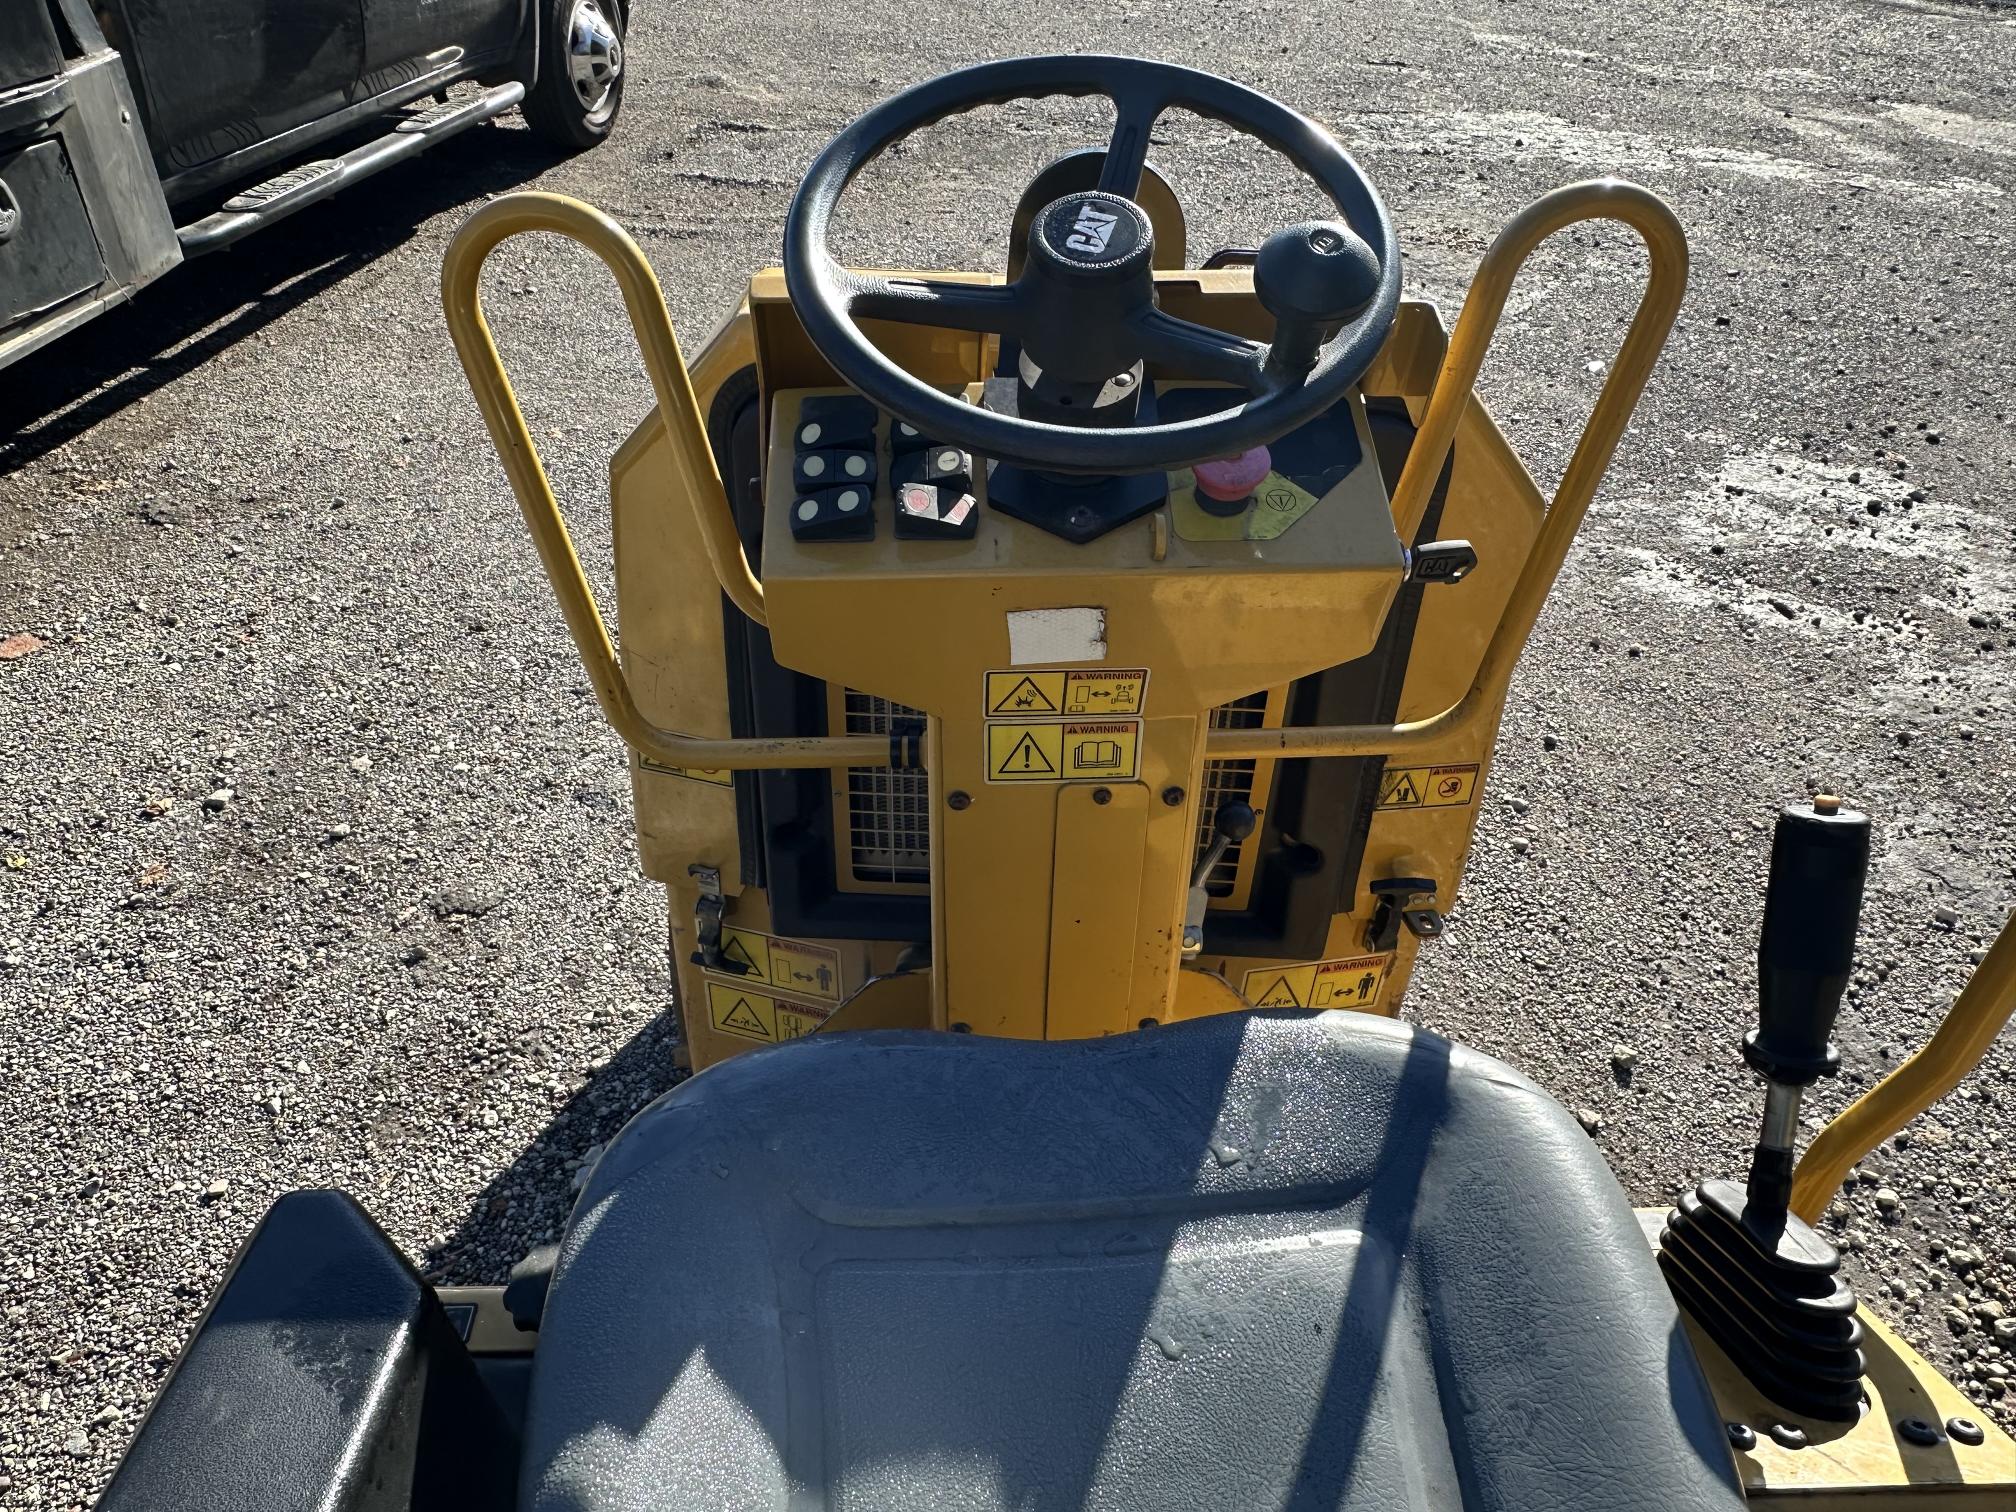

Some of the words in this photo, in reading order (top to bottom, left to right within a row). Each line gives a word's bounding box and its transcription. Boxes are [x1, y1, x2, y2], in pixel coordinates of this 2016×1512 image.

[1066, 204, 1118, 253] CAT
[1086, 672, 1141, 680] WARNING
[1080, 725, 1128, 734] WARNING
[1333, 959, 1383, 971] WARNING
